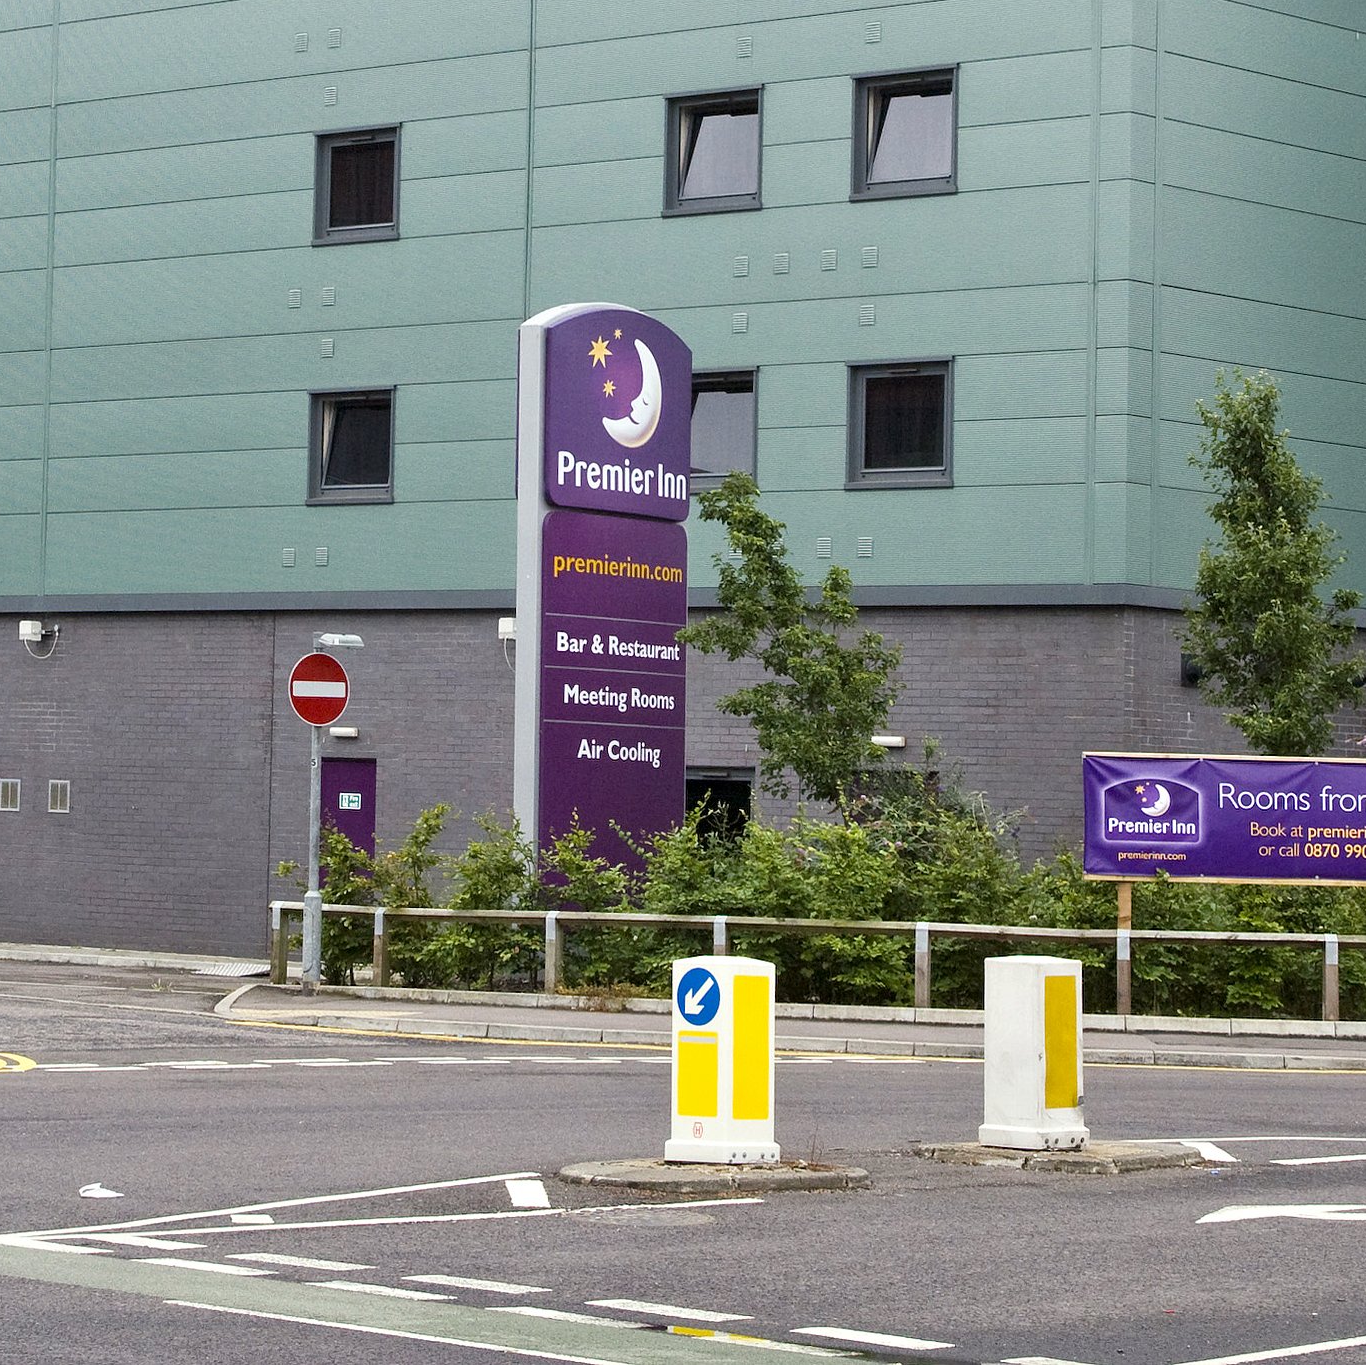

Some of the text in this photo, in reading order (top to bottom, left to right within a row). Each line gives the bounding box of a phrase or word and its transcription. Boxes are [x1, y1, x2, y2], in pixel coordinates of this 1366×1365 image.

[557, 450, 687, 501] Premier Inn
[553, 553, 683, 583] premierinn.com
[556, 631, 680, 661] Bar & Restaurant
[563, 683, 675, 713] Meeting Rooms
[577, 738, 661, 768] Air Cooling
[1218, 783, 1311, 811] Rooms
[1108, 818, 1196, 835] Premier Inn
[1250, 822, 1286, 837] Book
[1290, 825, 1304, 838] at
[1117, 850, 1187, 862] premierinn.com
[1258, 846, 1275, 857] or
[1278, 843, 1300, 857] call
[1304, 843, 1340, 858] 0870
